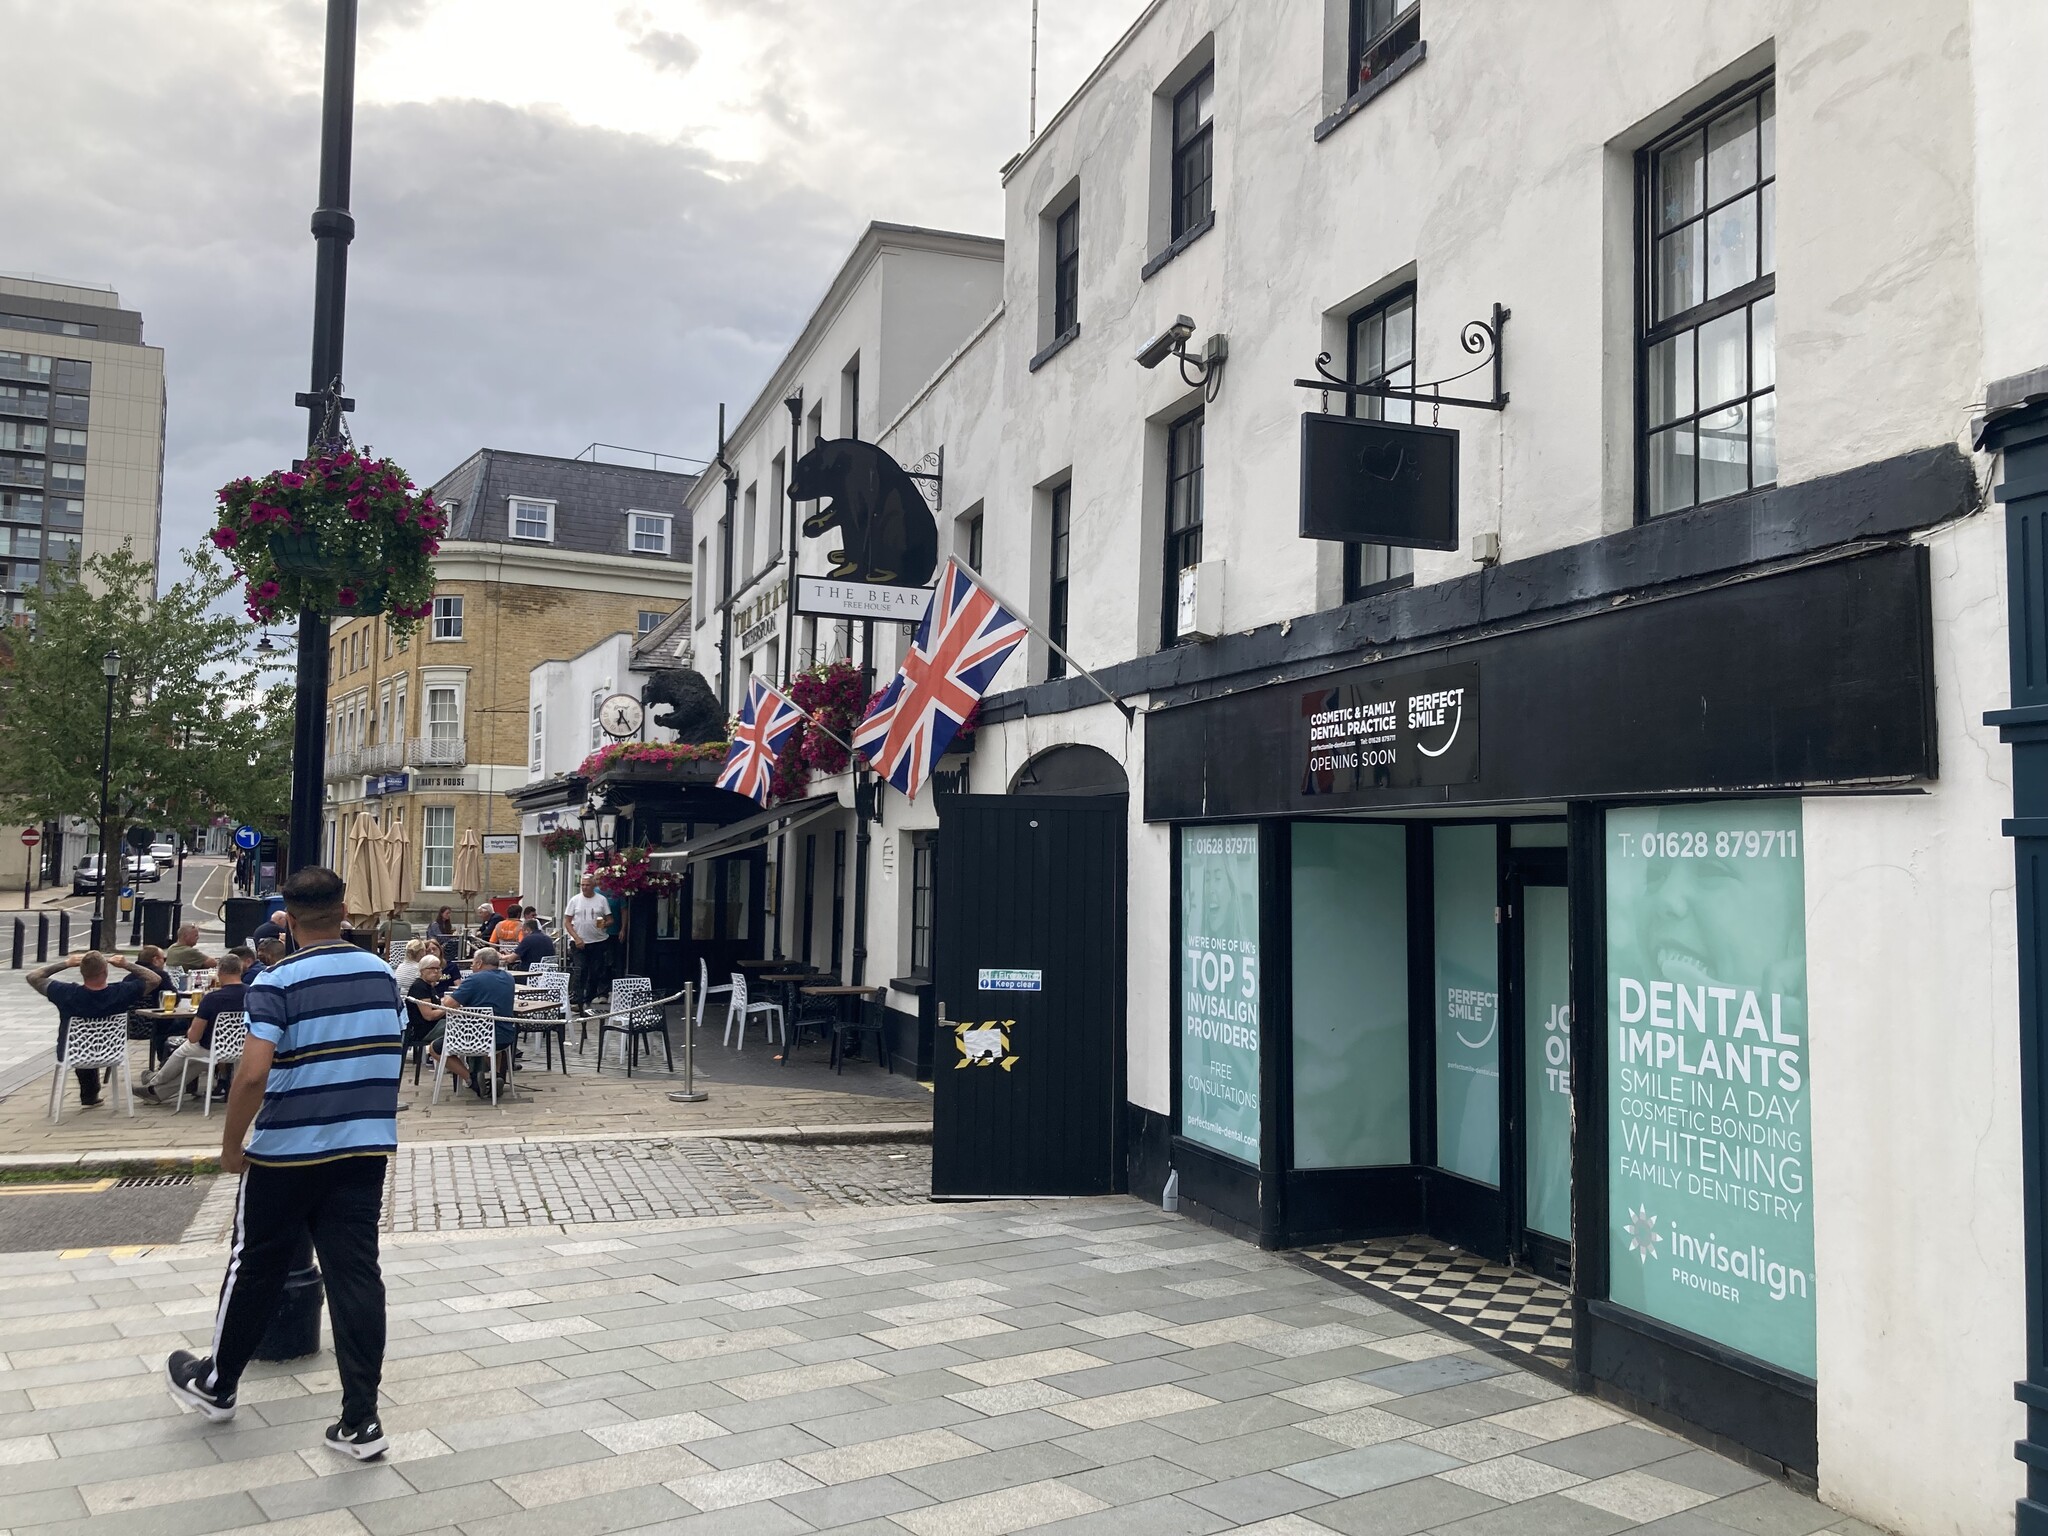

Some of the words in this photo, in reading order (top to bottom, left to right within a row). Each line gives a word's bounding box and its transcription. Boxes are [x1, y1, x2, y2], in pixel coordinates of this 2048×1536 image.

[815, 586, 854, 600] THE
[868, 590, 920, 605] BEAR
[843, 601, 862, 609] FREE
[863, 603, 892, 611] HOUSE
[734, 604, 752, 638] THE
[1310, 707, 1353, 726] COSMETIC
[1354, 708, 1361, 718] &
[1362, 700, 1397, 718] FAMILY
[1408, 688, 1464, 713] PERFECT
[1310, 722, 1346, 740] DENTAL
[1347, 716, 1397, 735] PRACTICE
[1408, 709, 1445, 730] SMILE
[1310, 753, 1358, 772] OPENING
[1361, 749, 1396, 766] SOON
[443, 778, 464, 786] HOUSE
[1187, 838, 1195, 854] T:
[1196, 838, 1222, 854] 01628
[1225, 837, 1256, 854] 879711
[1618, 833, 1635, 858] T:
[1641, 832, 1709, 858] 01628
[1715, 829, 1797, 858] 879711
[1211, 938, 1226, 951] ONE
[1227, 940, 1238, 952] OF
[995, 980, 1014, 989] Keep
[1188, 949, 1234, 992] TOP
[1241, 956, 1256, 998] 5
[1187, 991, 1257, 1025] INVISALIGN
[1448, 988, 1498, 1009] PERFECT
[1448, 1003, 1482, 1022] SMILE
[1619, 977, 1800, 1047] DENTAL
[1187, 1015, 1258, 1051] PROVIDERS
[1545, 1035, 1570, 1066] O
[1619, 1026, 1801, 1092] IMPLANTS
[1210, 1060, 1232, 1081] FREE
[1187, 1074, 1258, 1109] CONSULTATIONS
[1620, 1068, 1684, 1103] SMILE
[1691, 1080, 1713, 1109] IN
[1721, 1087, 1740, 1114] A
[1747, 1090, 1801, 1125] DAY
[1187, 1115, 1258, 1148] perfectsmile-dental.com
[1620, 1097, 1705, 1132] COSMETIC
[1710, 1115, 1802, 1153] BONDING
[1621, 1119, 1804, 1194] WHITENING
[1620, 1156, 1682, 1190] FAMILY
[1688, 1174, 1803, 1223] DENTISTRY
[1671, 1221, 1807, 1301] invisalign
[1672, 1267, 1740, 1304] PROVIDER
